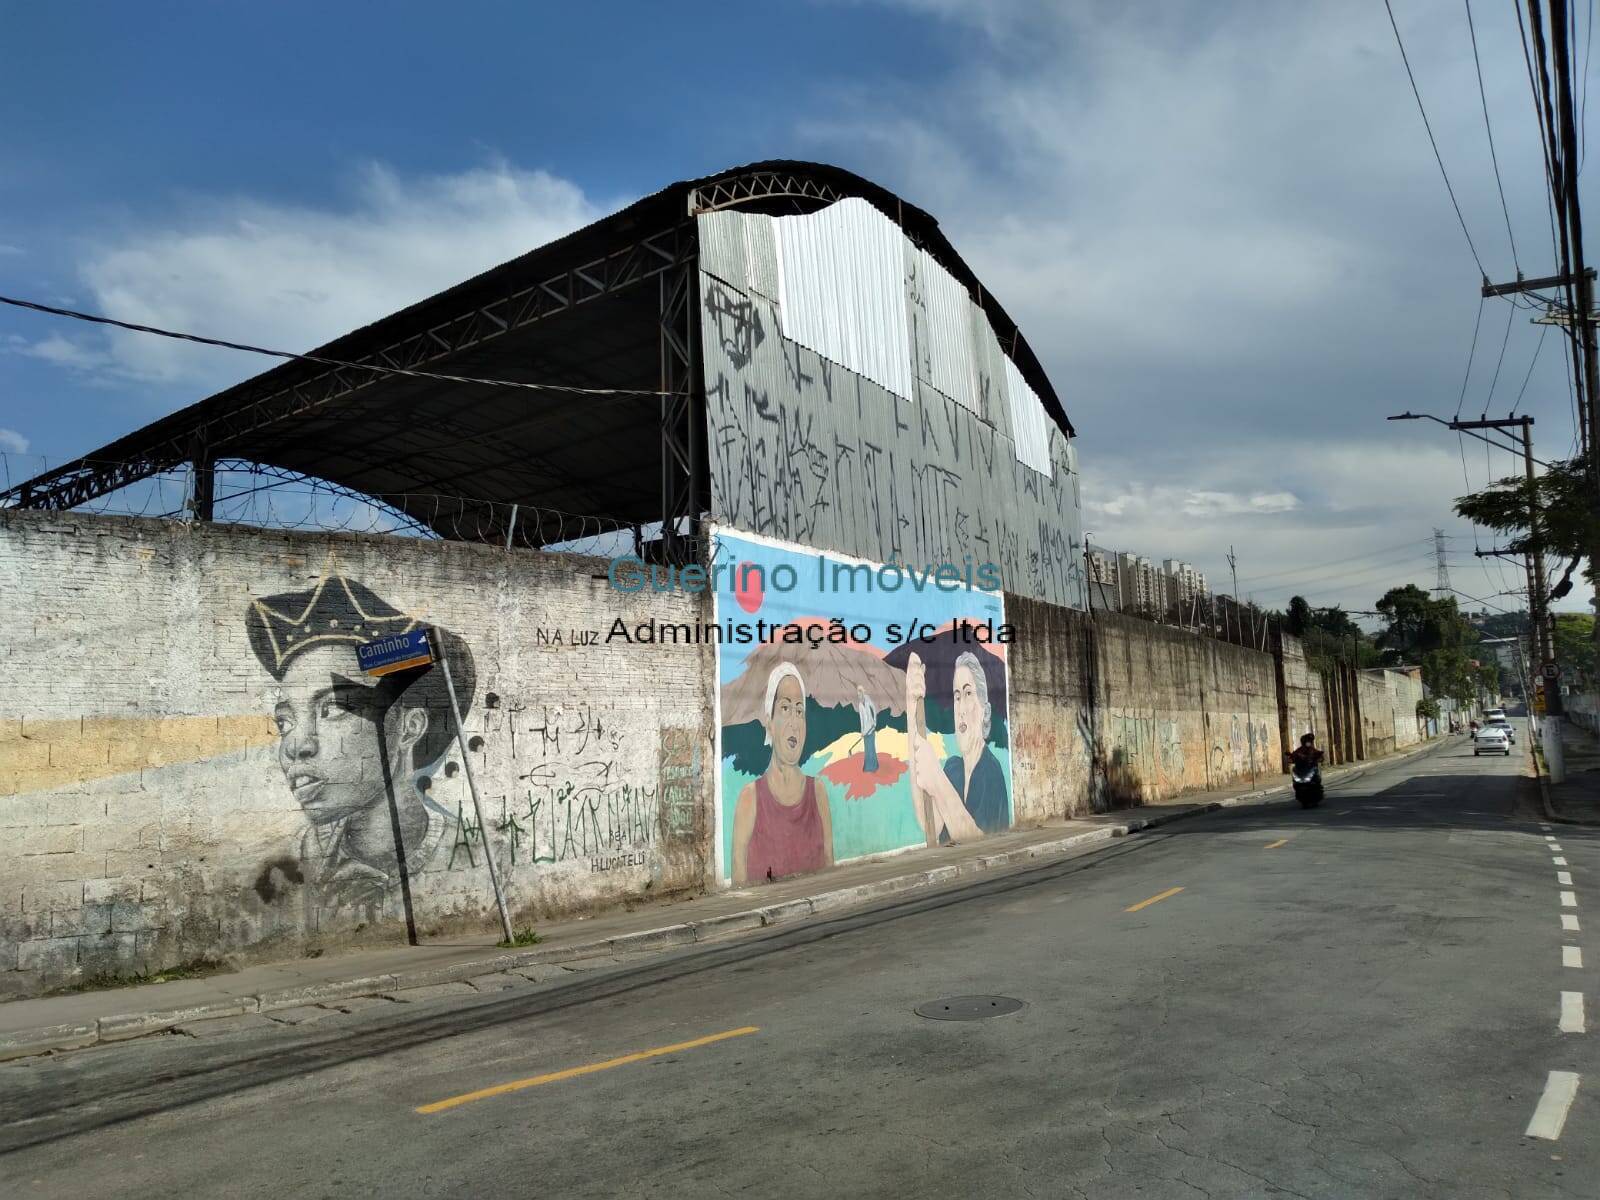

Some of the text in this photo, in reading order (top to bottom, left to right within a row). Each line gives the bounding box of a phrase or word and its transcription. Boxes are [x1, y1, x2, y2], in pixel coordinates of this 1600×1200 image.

[536, 627, 599, 646] NA LUZ
[358, 637, 409, 659] Caminho
